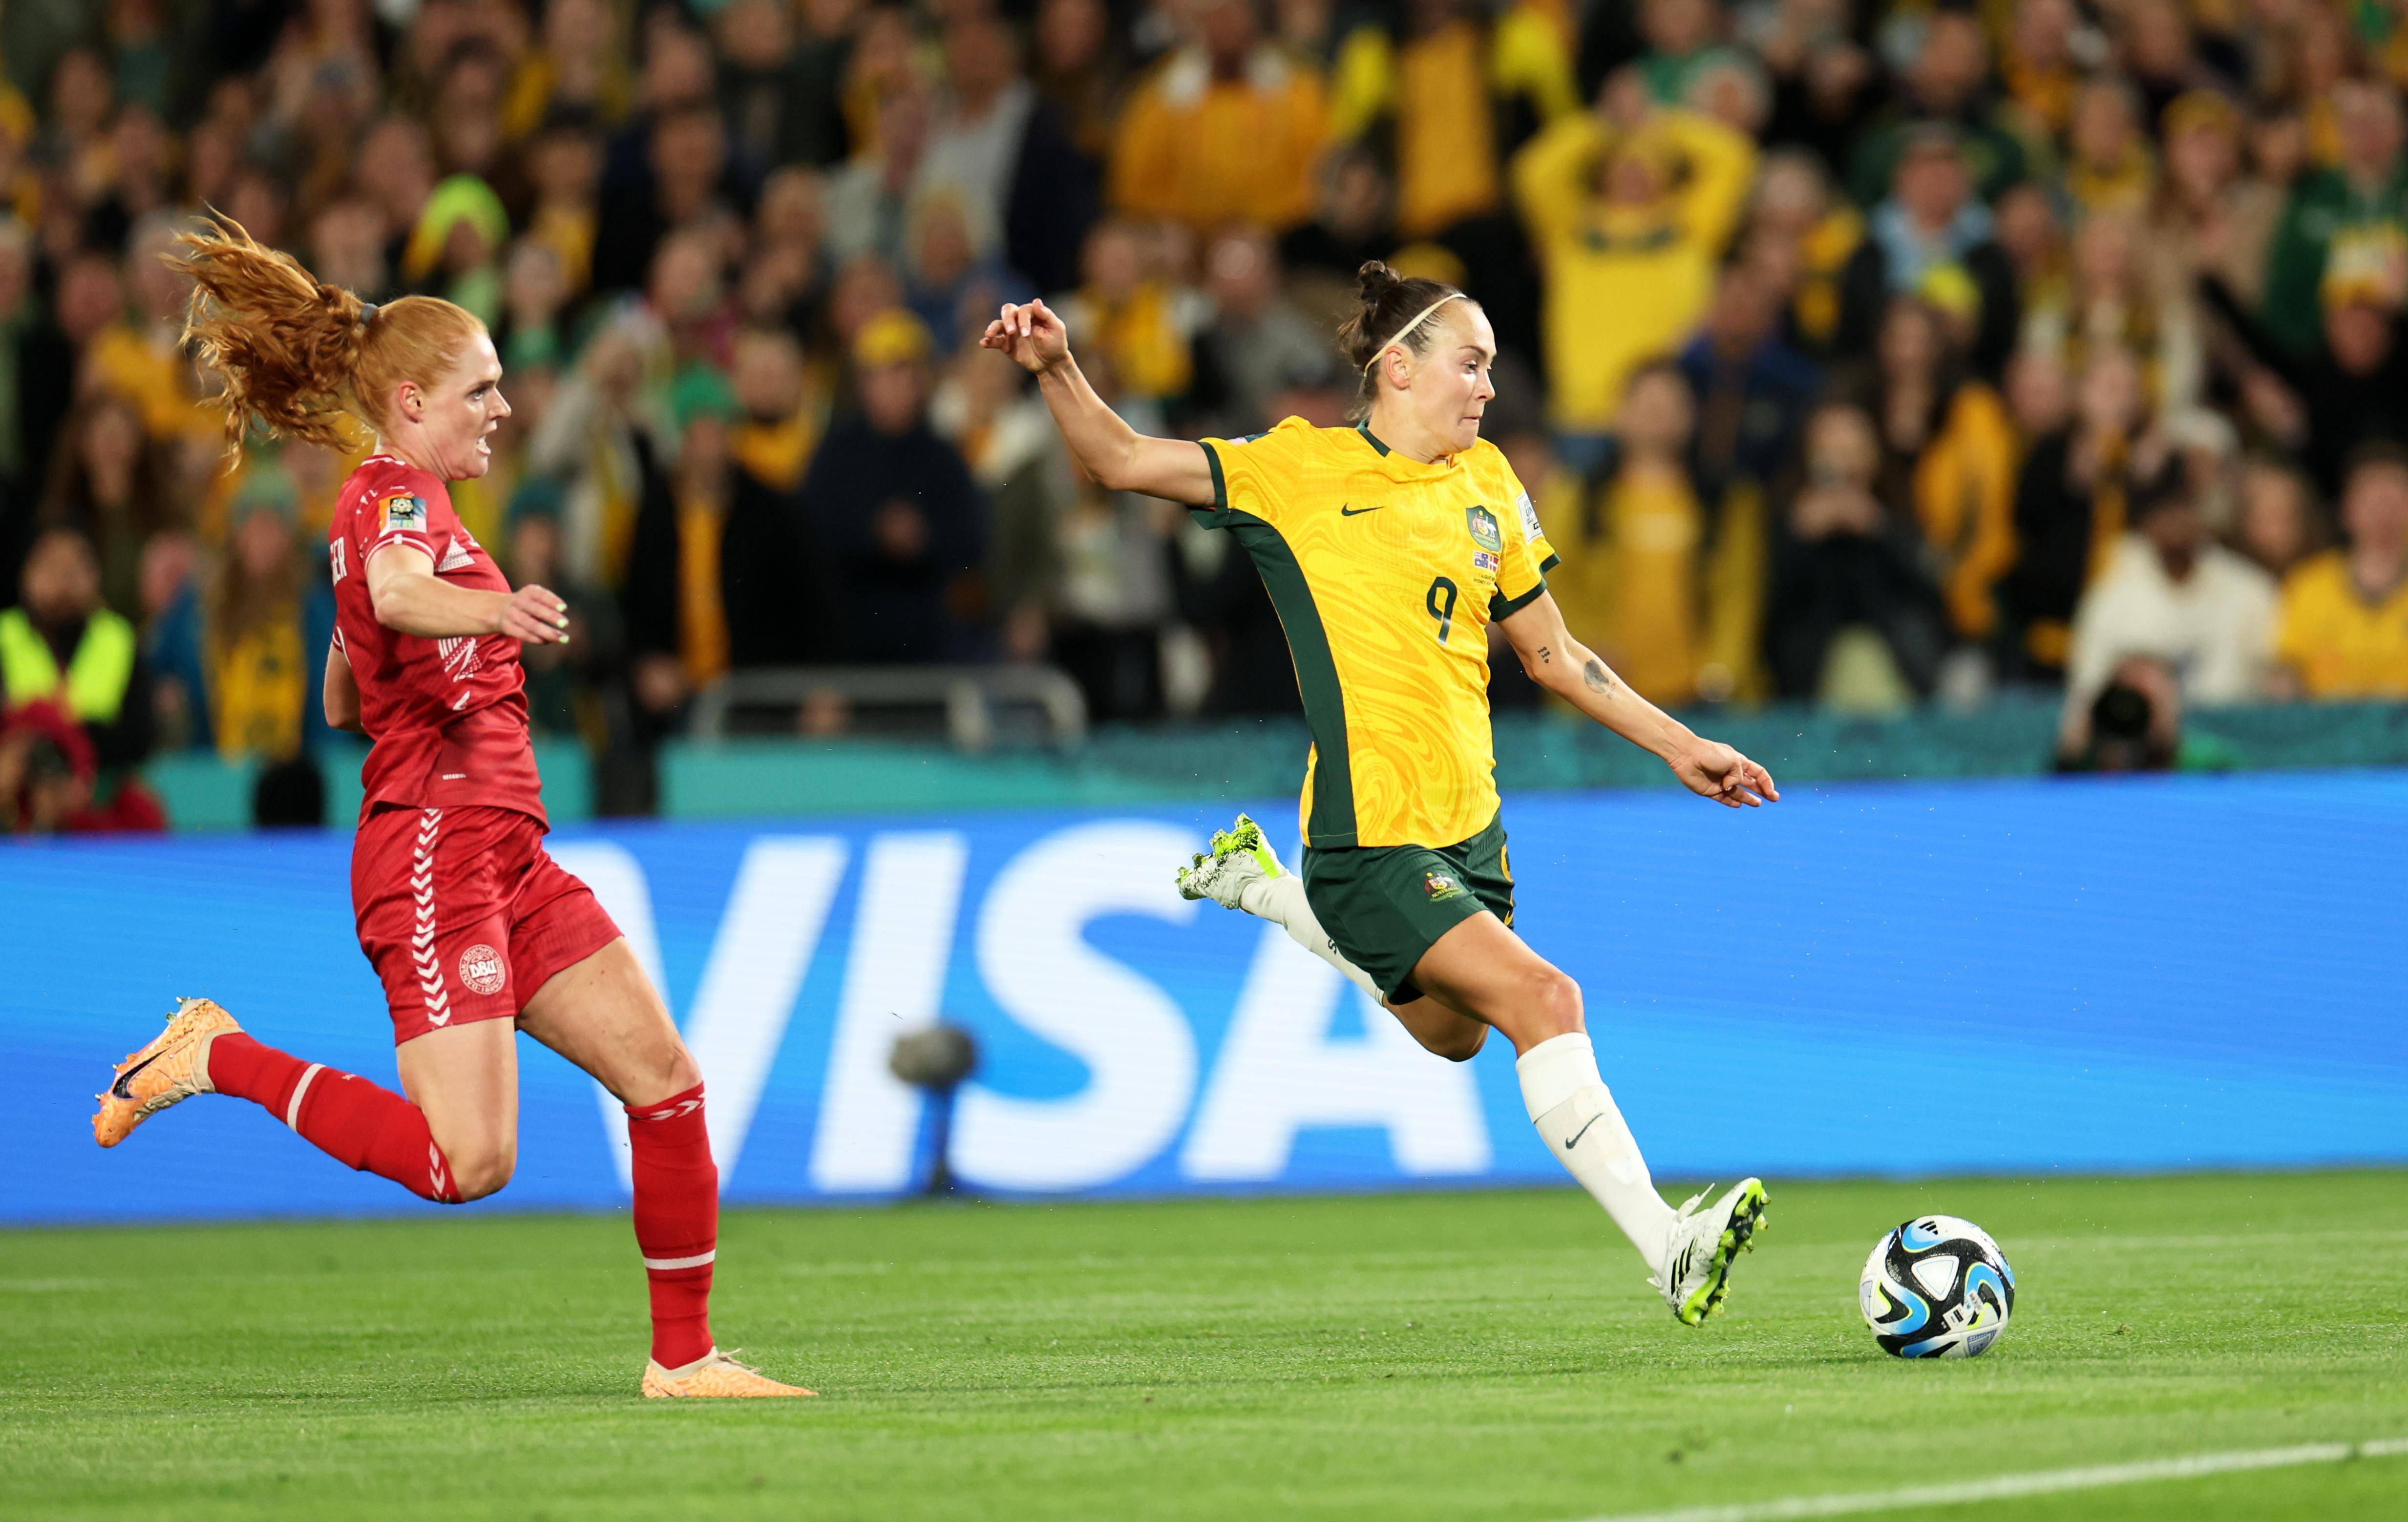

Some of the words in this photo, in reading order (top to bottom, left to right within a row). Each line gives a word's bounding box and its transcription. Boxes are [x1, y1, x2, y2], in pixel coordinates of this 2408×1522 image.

[1427, 576, 1457, 646] 9
[1432, 886, 1459, 898] AUSTRALIA
[468, 959, 497, 979] DBU
[541, 818, 1493, 1192] VISA
